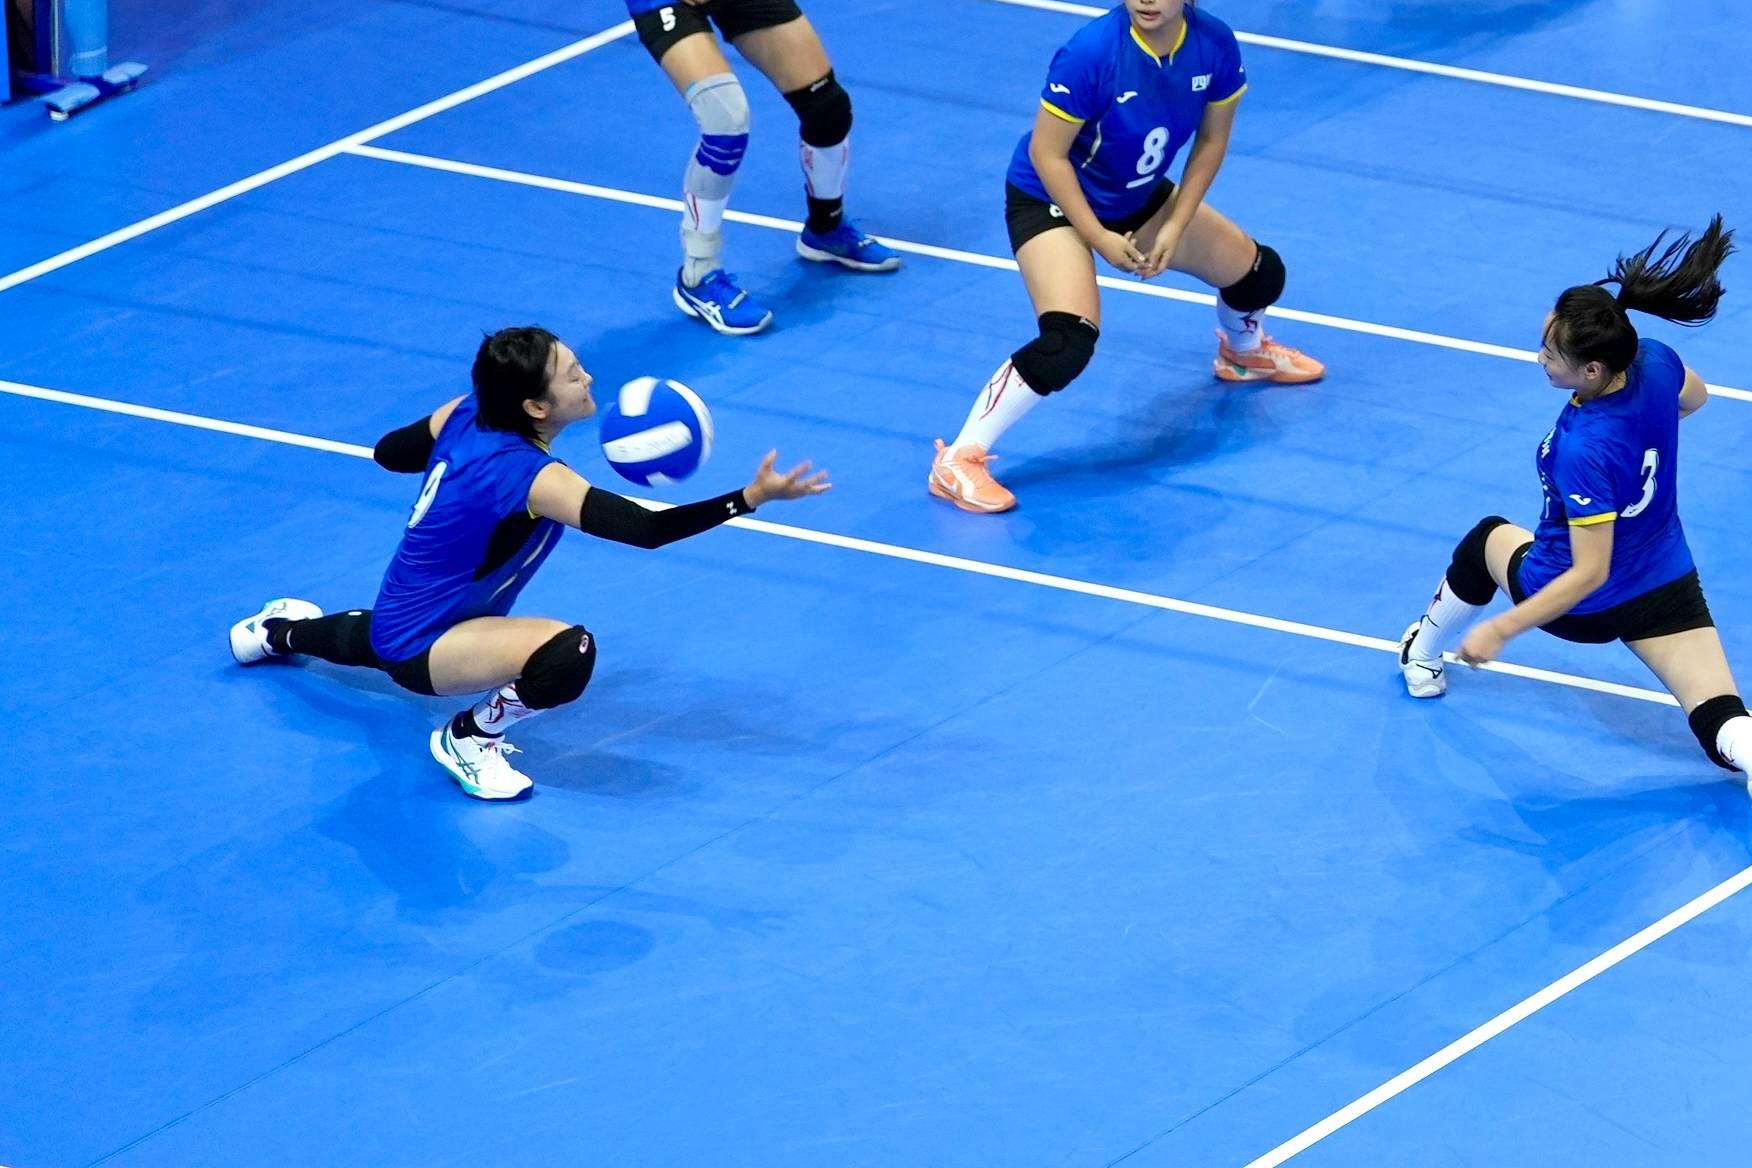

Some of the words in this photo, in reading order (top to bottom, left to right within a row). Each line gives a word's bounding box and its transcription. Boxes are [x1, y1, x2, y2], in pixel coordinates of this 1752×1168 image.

[659, 6, 676, 32] 5
[1136, 126, 1170, 175] 8
[1620, 448, 1660, 518] 3
